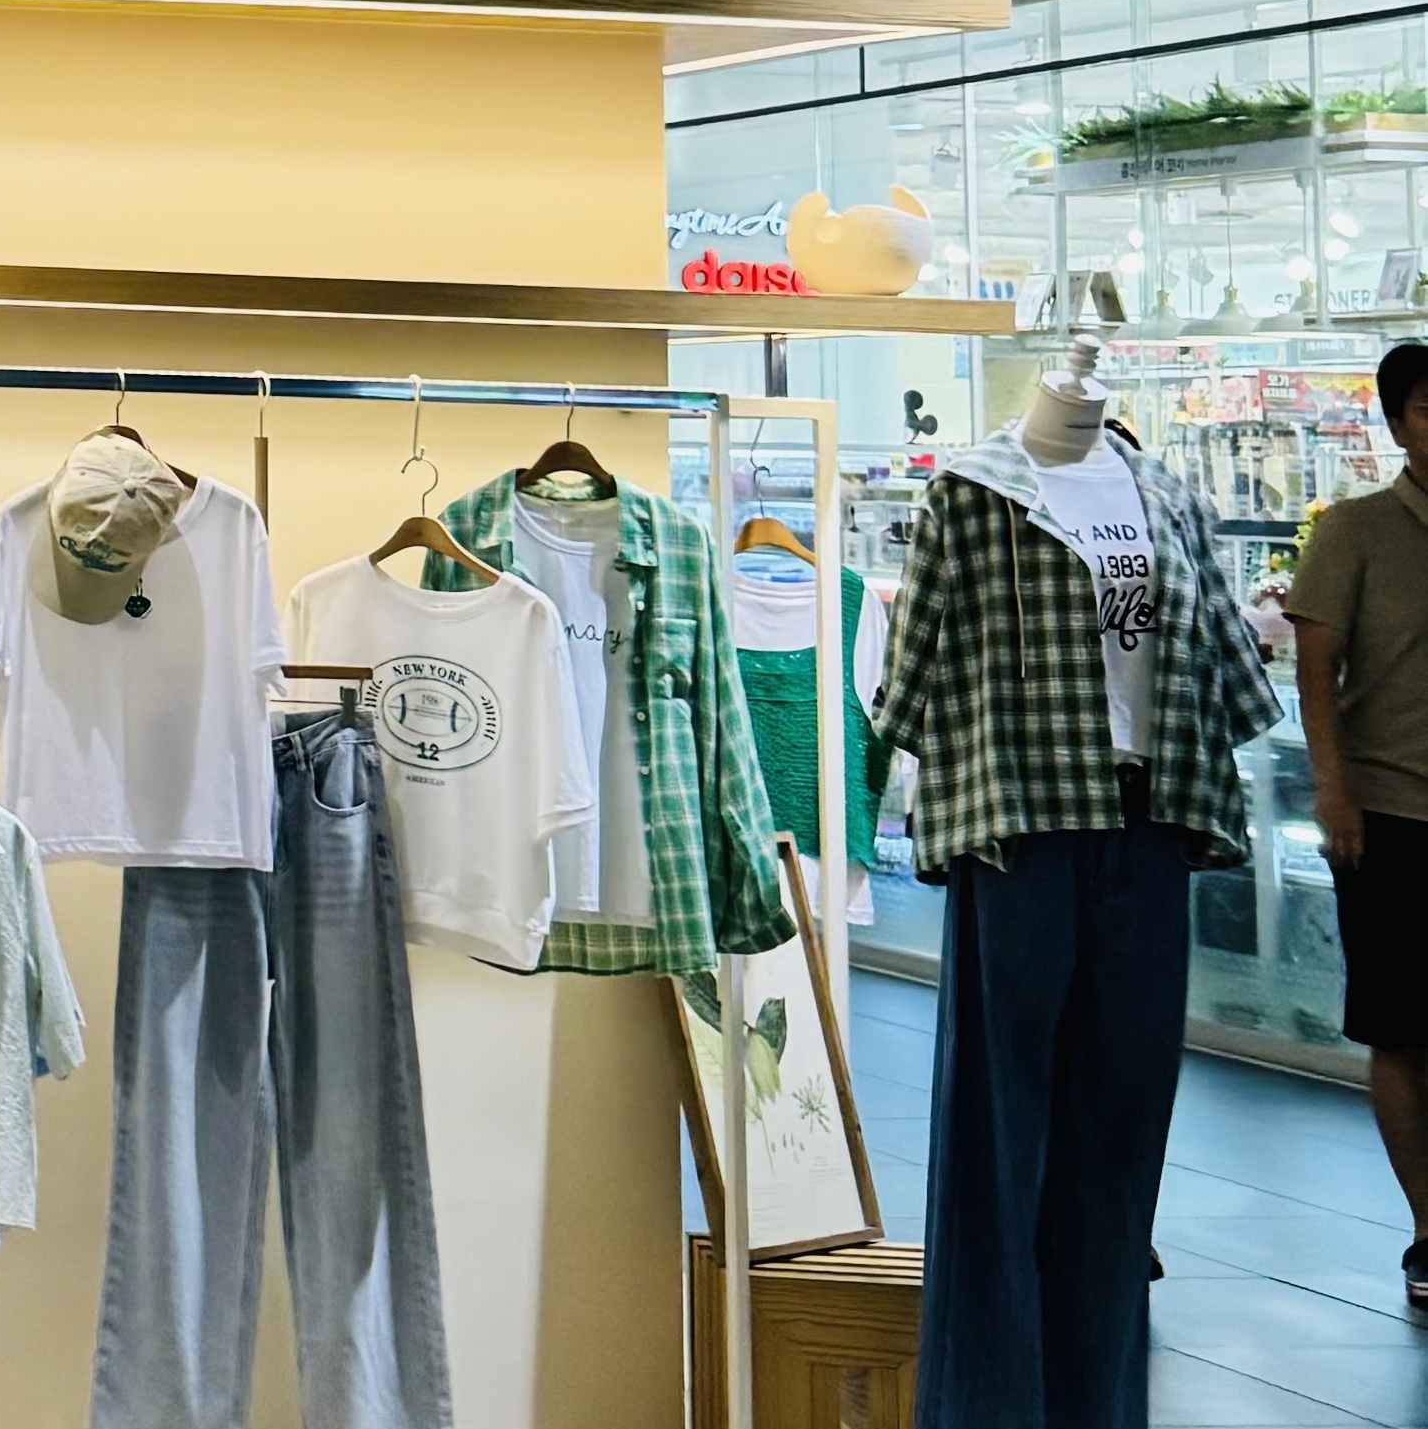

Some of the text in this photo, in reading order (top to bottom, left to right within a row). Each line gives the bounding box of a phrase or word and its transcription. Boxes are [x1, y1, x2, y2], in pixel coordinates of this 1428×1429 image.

[1091, 523, 1139, 542] AND
[1096, 554, 1150, 580] 1983
[392, 662, 468, 686] NEW YORK
[416, 741, 441, 762] 12
